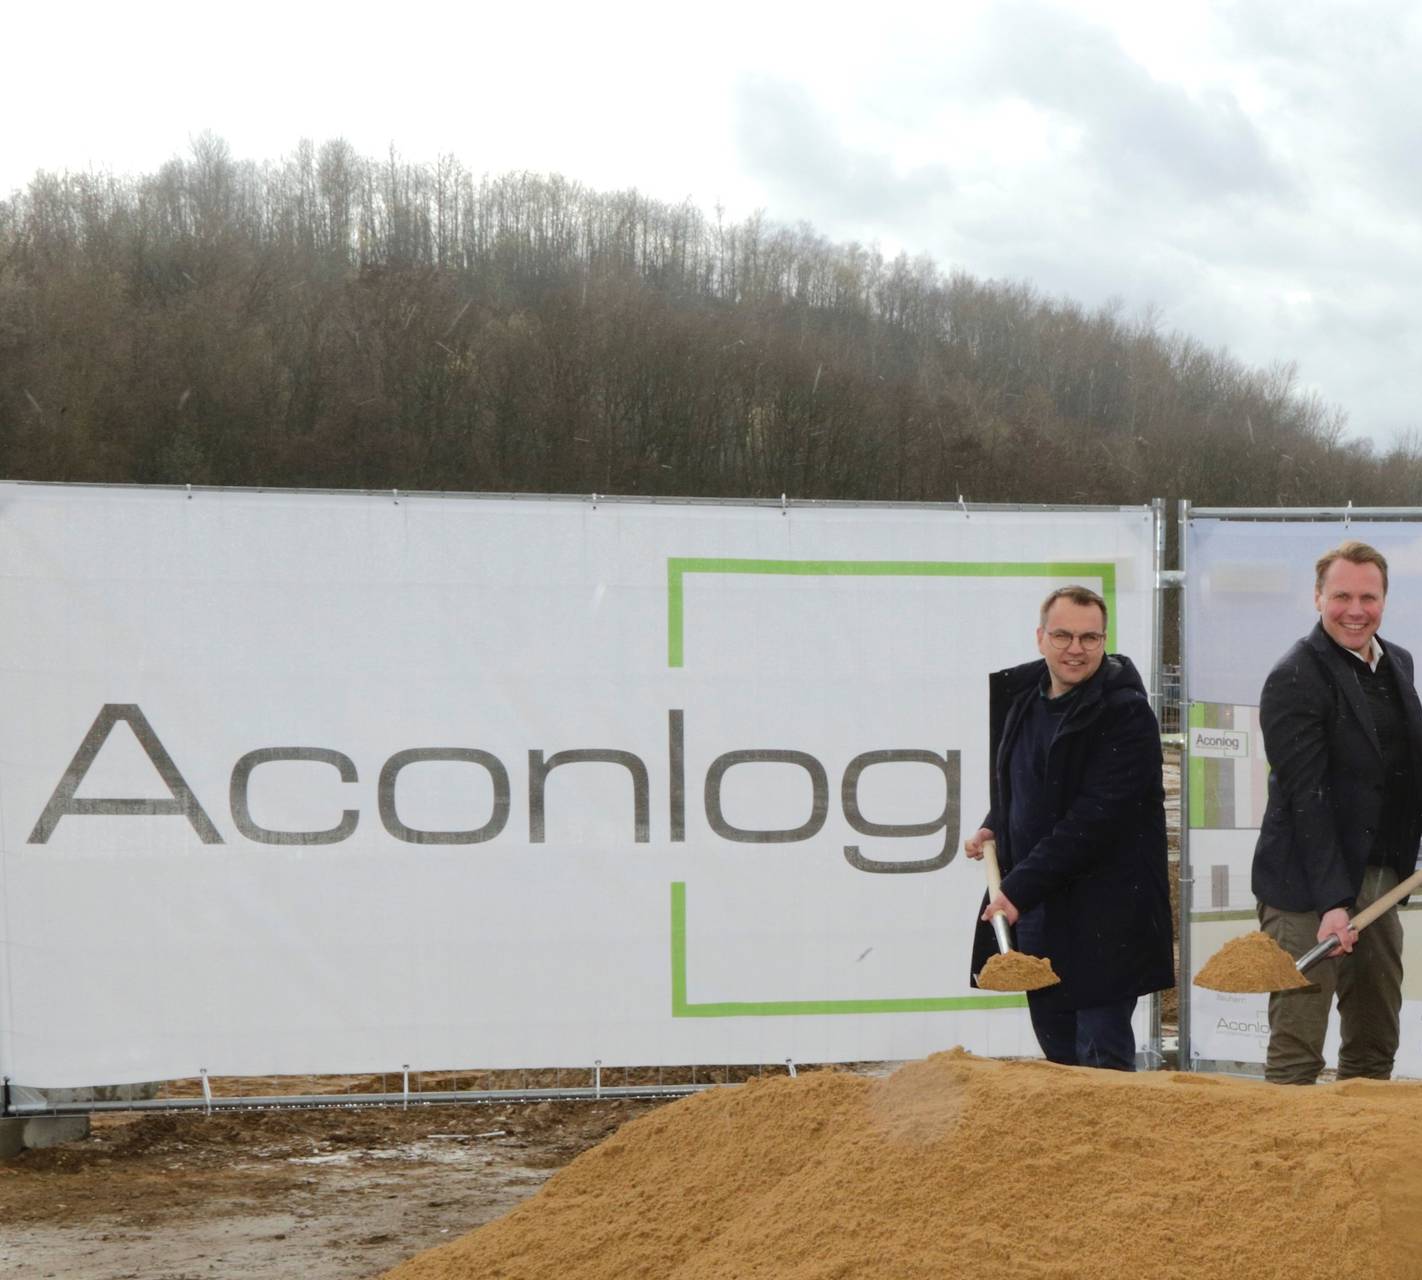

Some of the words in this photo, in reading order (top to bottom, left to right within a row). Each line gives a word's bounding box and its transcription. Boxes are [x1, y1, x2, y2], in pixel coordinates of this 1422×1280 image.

[1196, 733, 1239, 751] Aconlog
[26, 703, 962, 874] Aconlog
[1217, 1017, 1272, 1034] Aconlo
